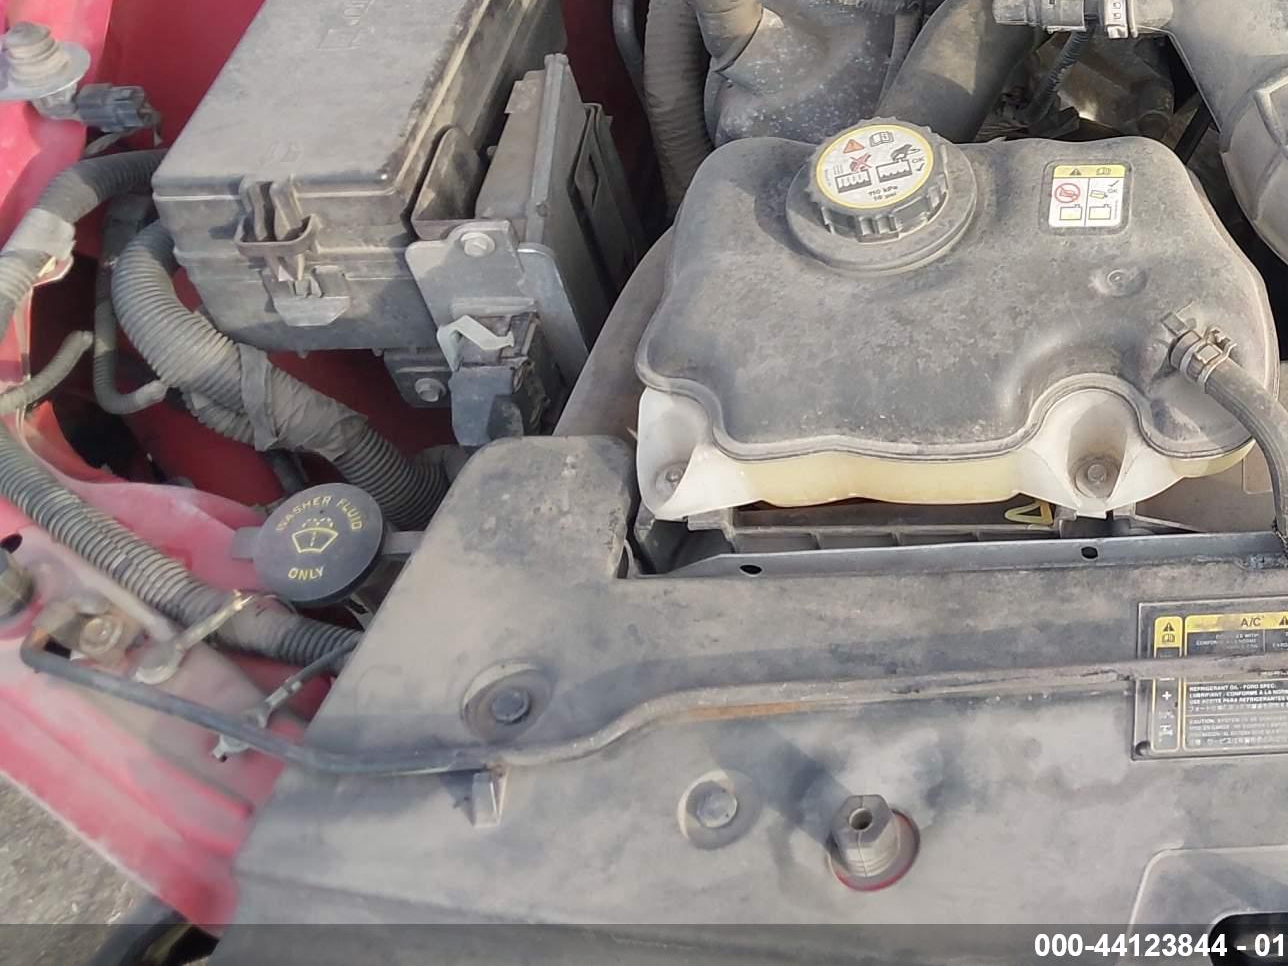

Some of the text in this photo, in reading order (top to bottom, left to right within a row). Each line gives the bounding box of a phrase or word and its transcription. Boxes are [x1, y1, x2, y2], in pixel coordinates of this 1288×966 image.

[912, 156, 925, 164] OK
[275, 495, 364, 531] WASHER FLUID
[287, 566, 324, 580] ONLY
[1240, 617, 1262, 627] A/C
